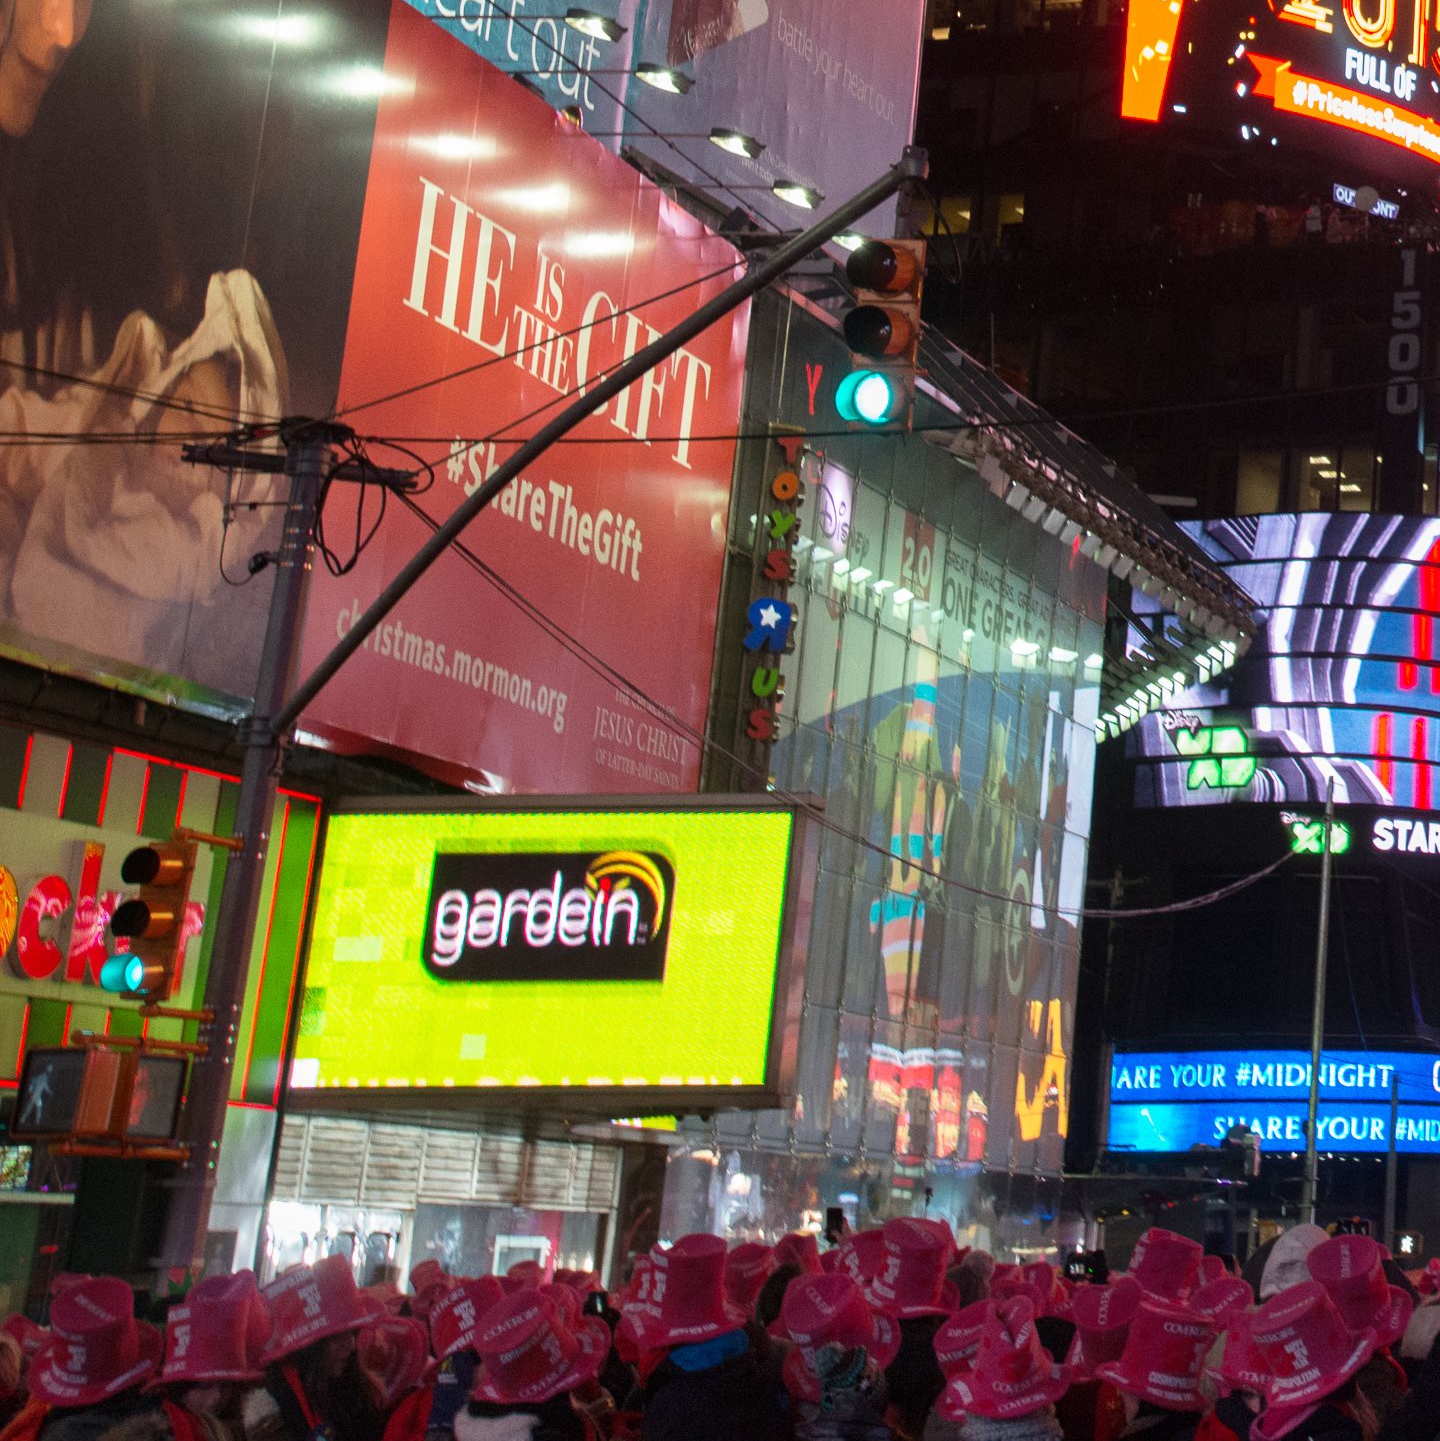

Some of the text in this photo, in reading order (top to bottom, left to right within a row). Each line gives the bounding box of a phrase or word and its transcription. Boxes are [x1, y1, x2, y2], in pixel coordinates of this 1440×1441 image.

[530, 16, 602, 113] out
[776, 8, 897, 126] battle your heart out
[1345, 47, 1418, 101] FULL OF
[402, 175, 518, 359] HE
[533, 253, 567, 323] IS
[512, 304, 574, 396] THE
[593, 705, 690, 766] JESUS CHRIST
[432, 870, 640, 967] gardein
[1170, 1063, 1395, 1089] YOUR #MIDNIGHT
[1314, 1118, 1385, 1141] YOUR
